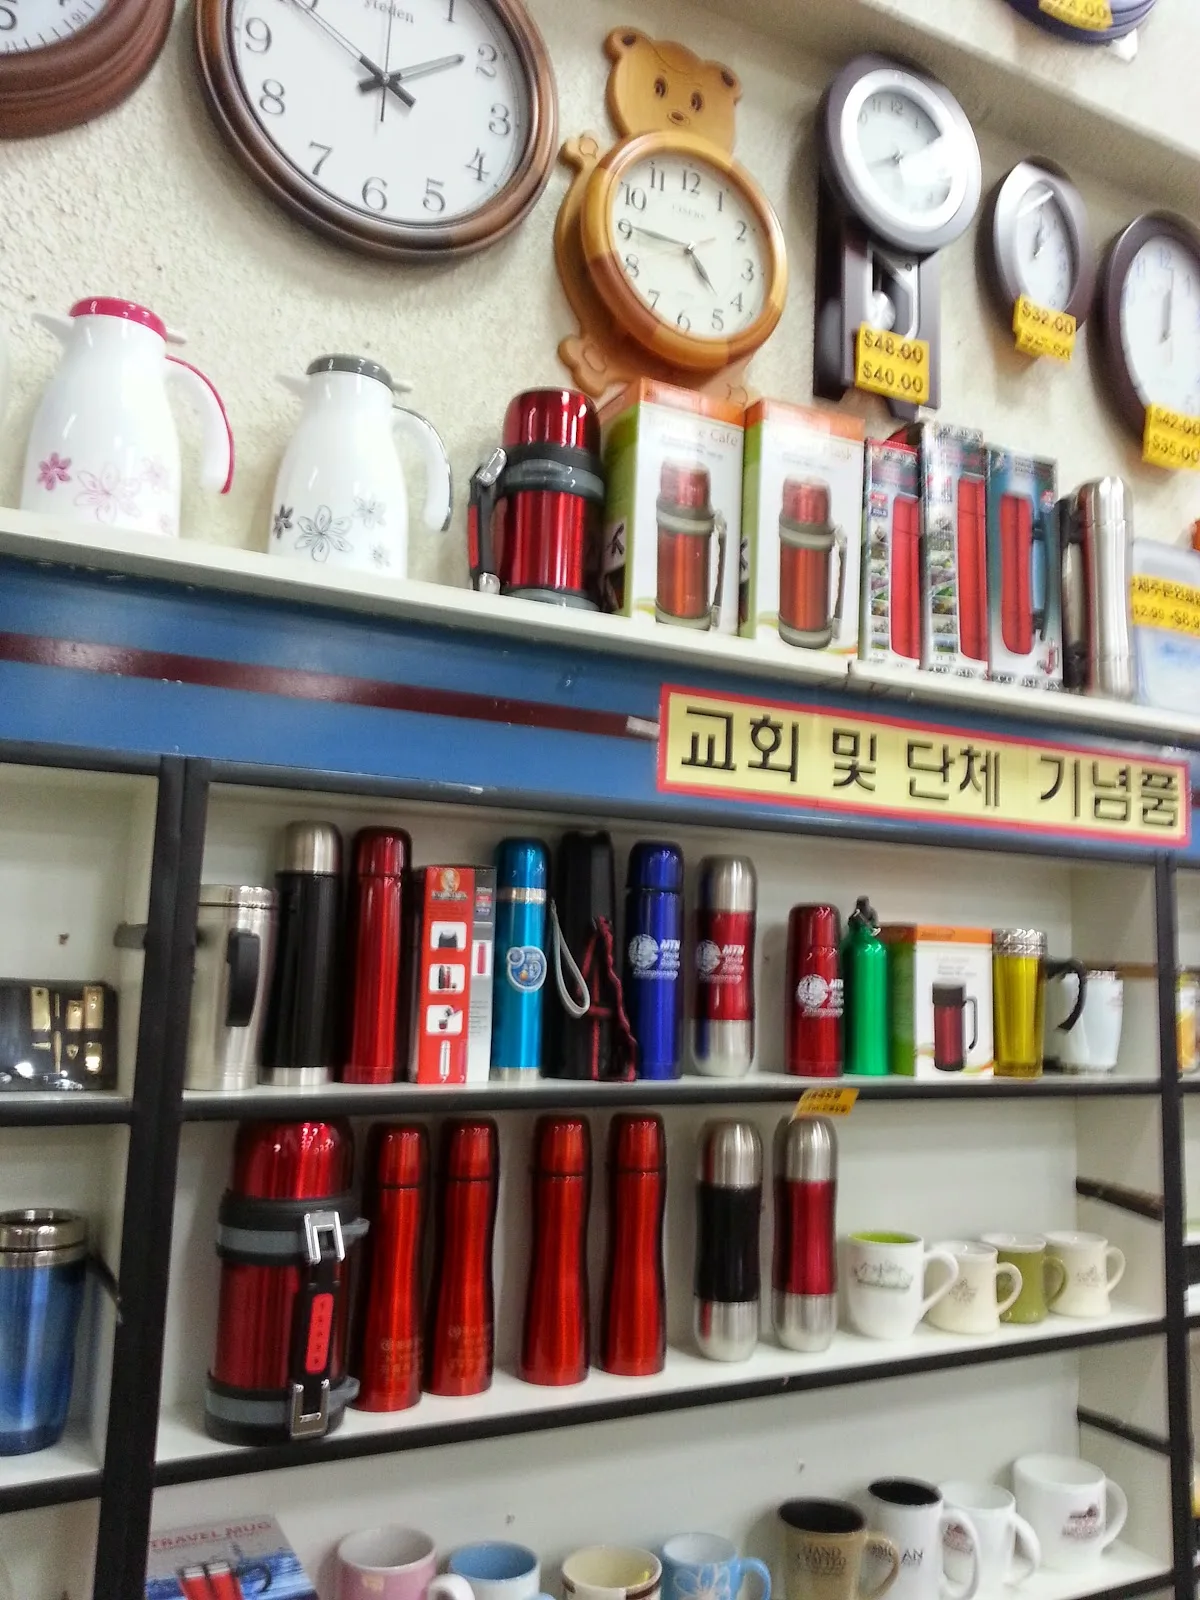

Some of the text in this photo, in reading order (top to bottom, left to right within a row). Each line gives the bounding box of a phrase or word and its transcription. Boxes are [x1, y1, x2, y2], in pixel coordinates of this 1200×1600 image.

[245, 17, 272, 54] 9
[476, 42, 498, 78] 2
[259, 79, 285, 115] 8
[488, 103, 511, 136] 3
[309, 140, 333, 176] 7
[465, 147, 489, 182] 4
[361, 176, 388, 211] 6
[649, 166, 665, 192] 11
[682, 169, 701, 196] 12
[422, 177, 446, 213] 5
[624, 183, 647, 211] 10
[618, 218, 633, 241] 9
[736, 220, 747, 243] 2
[624, 253, 640, 279] 8
[741, 258, 754, 282] 3
[648, 289, 660, 310] 7
[730, 292, 743, 313] 4
[677, 310, 691, 333] 6
[711, 308, 724, 332] 5
[1022, 300, 1073, 336] $32.00
[864, 330, 924, 364] $48.00
[863, 361, 924, 393] $40.00
[681, 706, 1179, 827] 교회 및 단체 기념품
[150, 1520, 272, 1550] TRAVEL MUG
